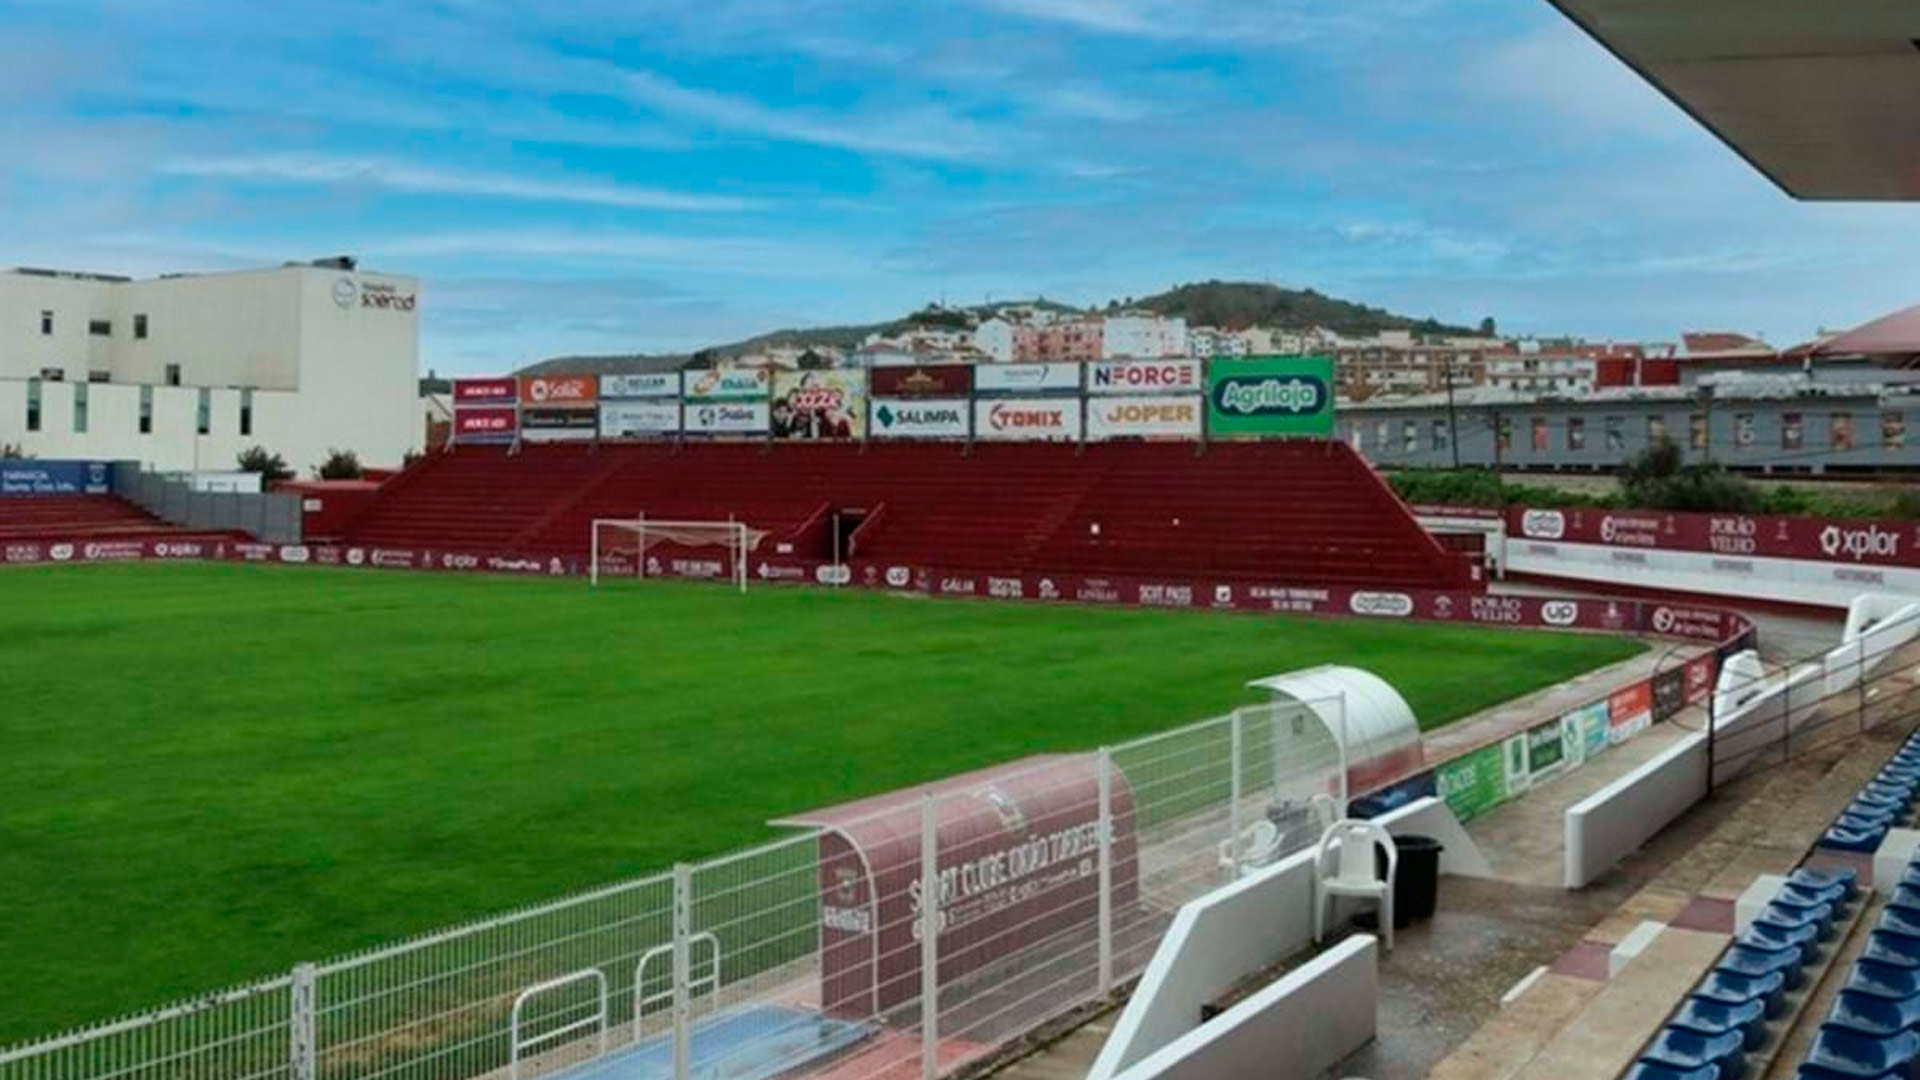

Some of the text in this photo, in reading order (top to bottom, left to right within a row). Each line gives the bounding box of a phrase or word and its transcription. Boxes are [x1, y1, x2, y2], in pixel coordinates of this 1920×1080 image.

[1095, 366, 1191, 384] NFORCE
[1222, 378, 1317, 412] Agriloja
[896, 409, 960, 424] SALIMPA
[1107, 404, 1193, 422] JOPER
[1710, 535, 1756, 552] VELHO
[1842, 524, 1900, 561] xplor
[1546, 603, 1573, 620] up
